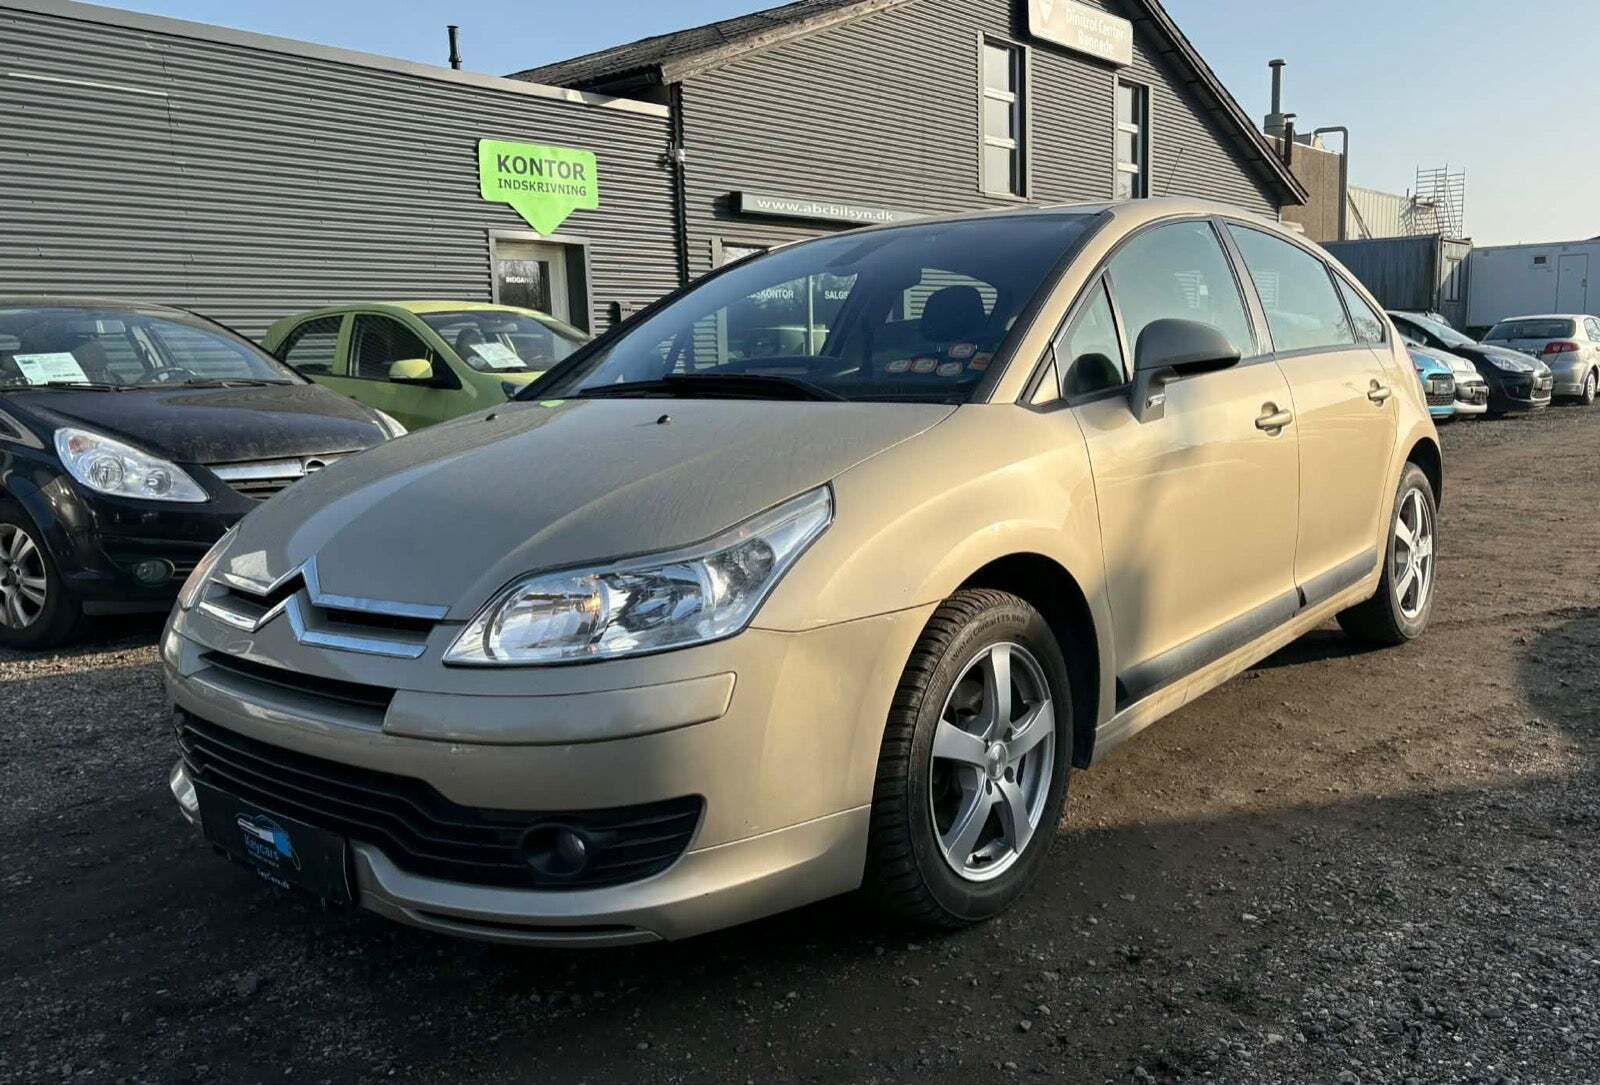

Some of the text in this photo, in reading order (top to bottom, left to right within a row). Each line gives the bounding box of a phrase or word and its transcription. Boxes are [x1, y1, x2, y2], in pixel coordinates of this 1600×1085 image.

[497, 153, 586, 181] KONTOR
[497, 178, 587, 197] INDSKRIVNING
[757, 199, 894, 222] www.abcbilsyn.dk
